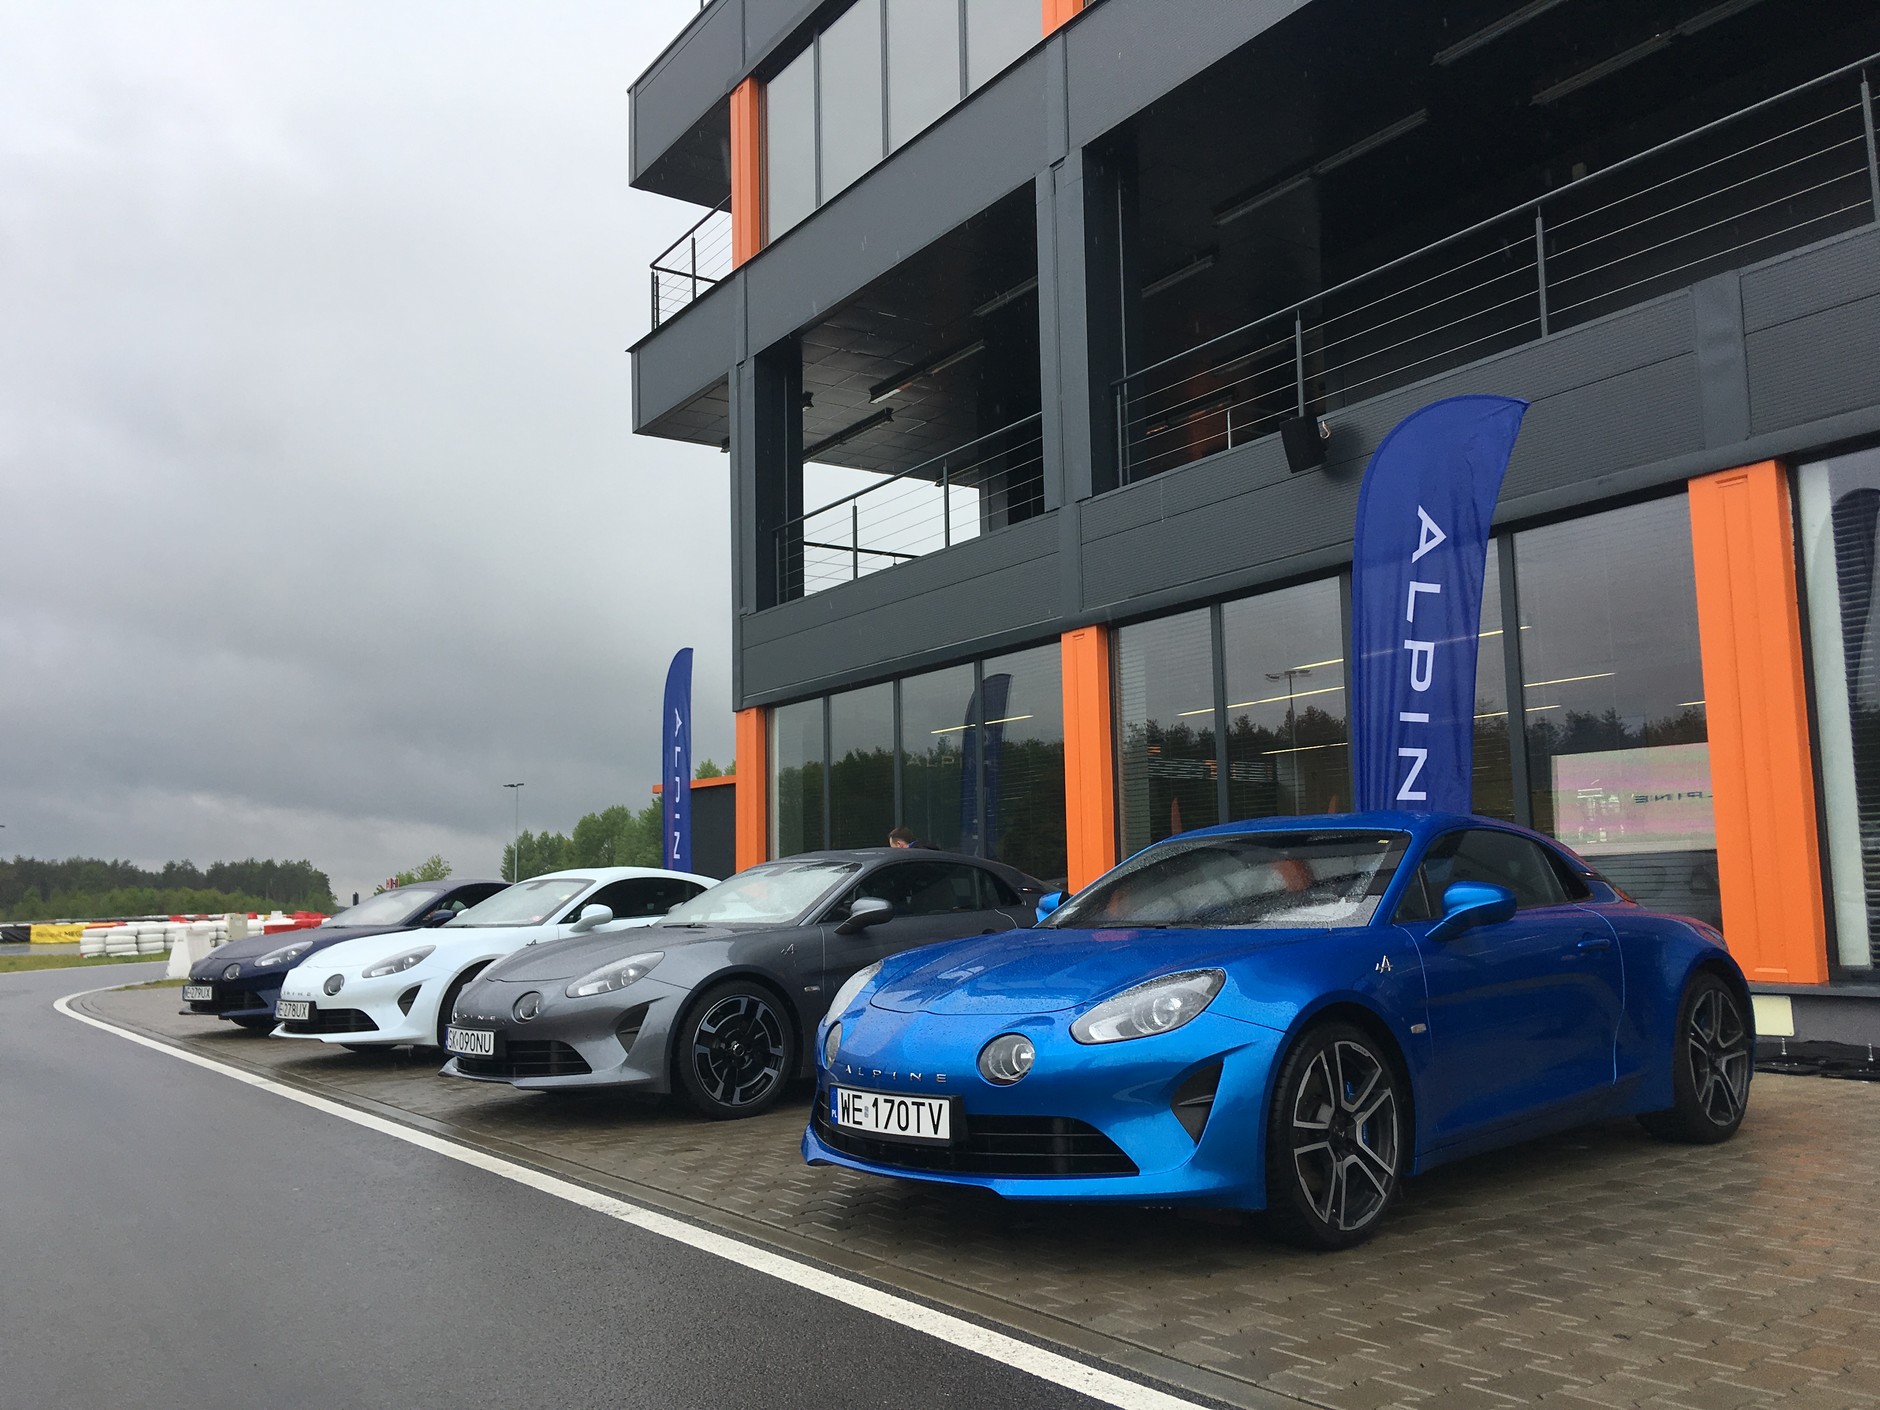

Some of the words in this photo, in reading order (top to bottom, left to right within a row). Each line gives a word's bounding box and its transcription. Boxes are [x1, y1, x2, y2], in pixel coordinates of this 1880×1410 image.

[1396, 505, 1447, 800] ALPIN
[673, 707, 683, 859] ALPIN
[459, 1031, 492, 1053] 090NU
[846, 1064, 947, 1083] ALPINE
[872, 1097, 943, 1135] 170TV
